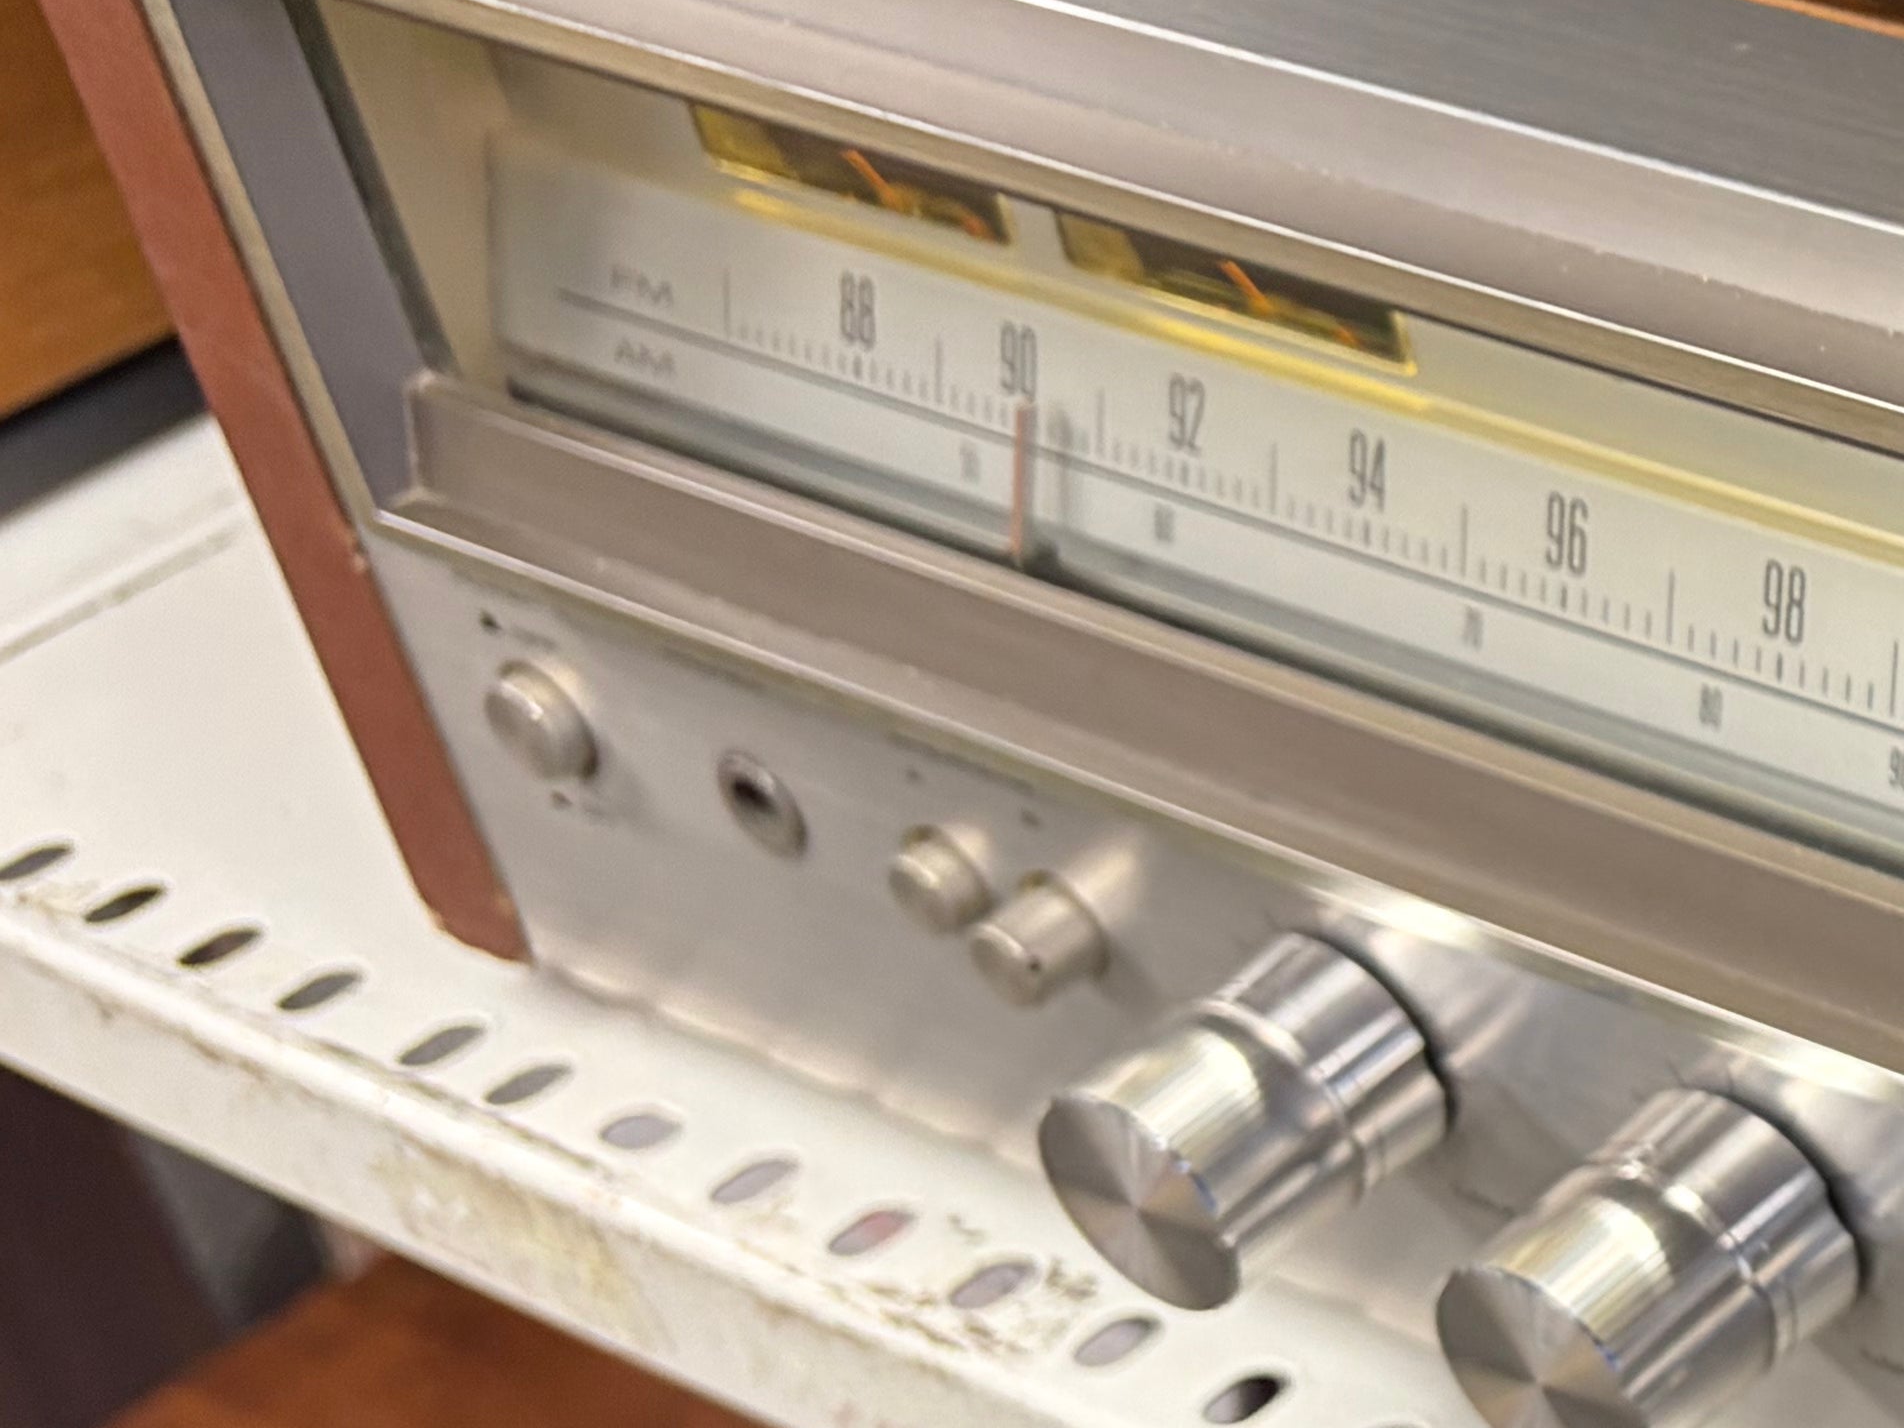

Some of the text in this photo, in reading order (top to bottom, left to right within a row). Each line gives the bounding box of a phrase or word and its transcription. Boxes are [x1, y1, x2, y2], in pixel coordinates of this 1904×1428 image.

[840, 270, 876, 351] 88
[1001, 320, 1037, 401] 90
[1167, 375, 1204, 452] 92
[1348, 428, 1387, 513] 94
[1545, 490, 1588, 575] 96
[1762, 558, 1806, 646] 98
